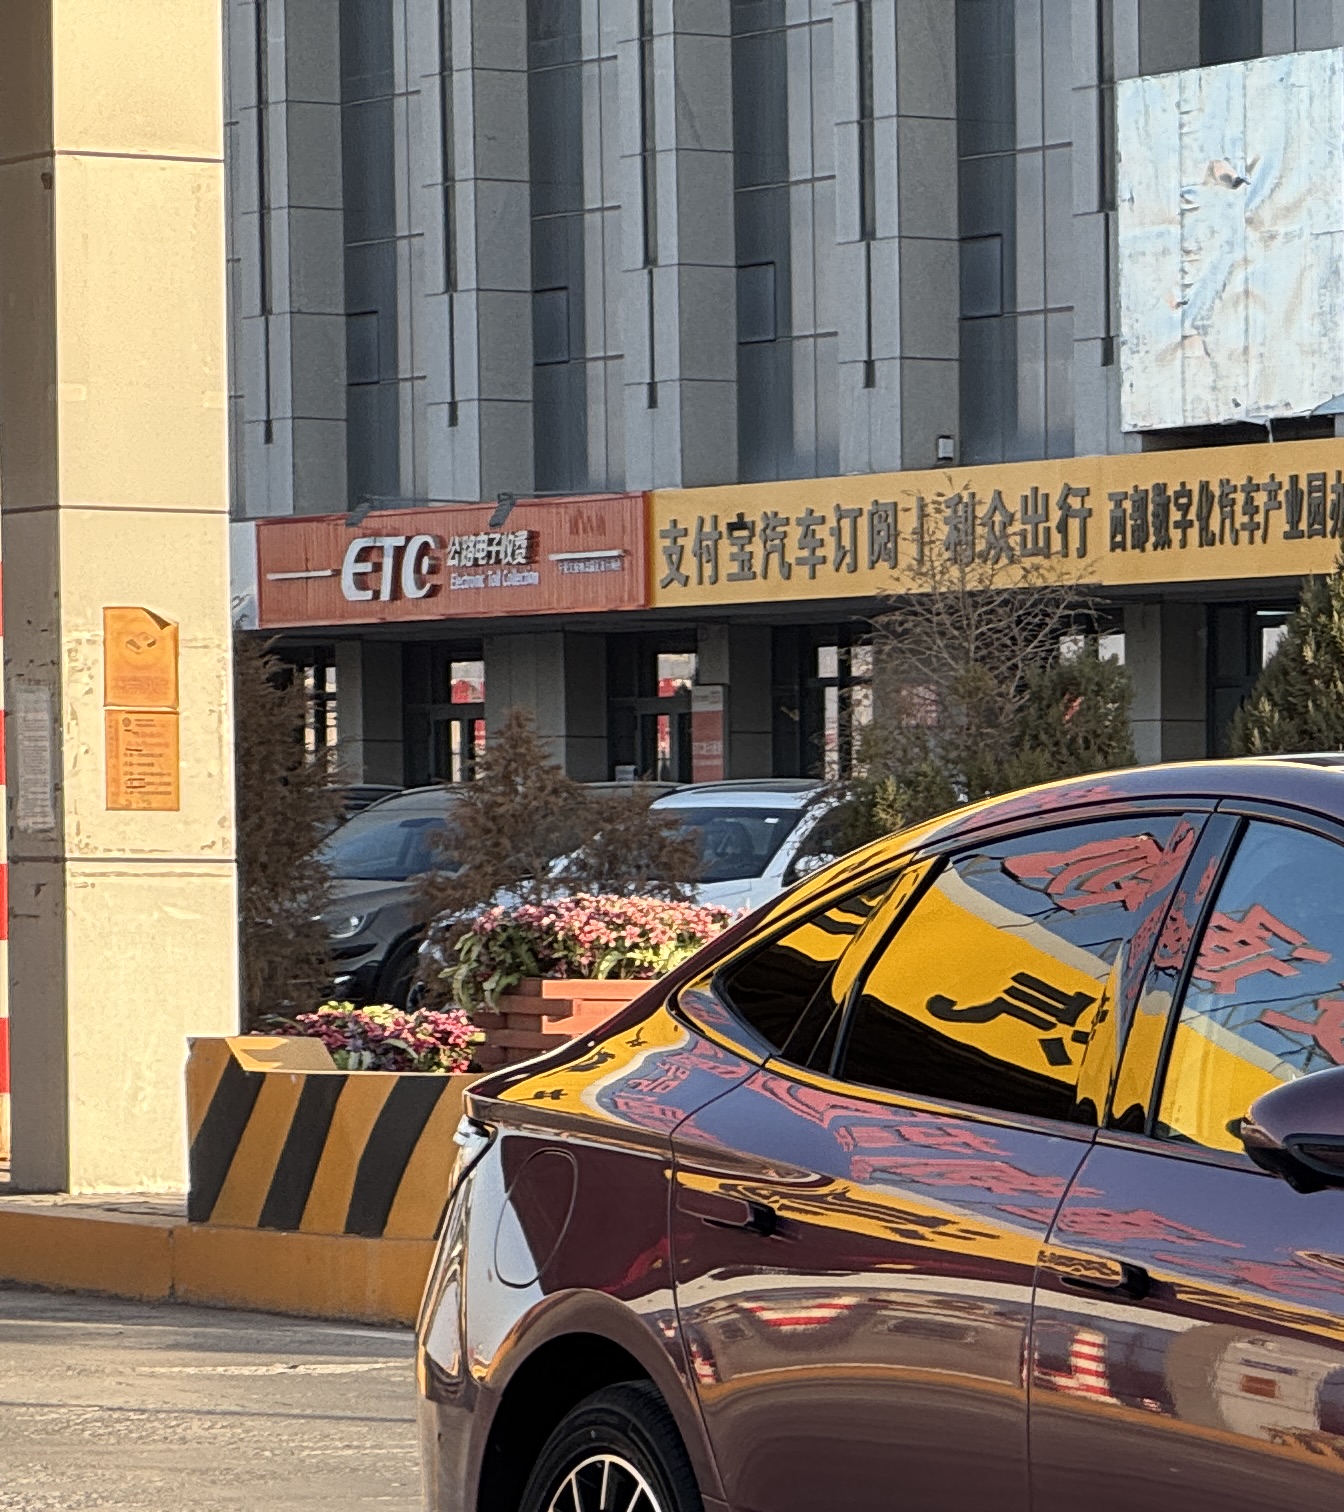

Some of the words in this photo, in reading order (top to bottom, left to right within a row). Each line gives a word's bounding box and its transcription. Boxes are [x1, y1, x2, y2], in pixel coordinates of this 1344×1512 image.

[340, 533, 438, 602] ETC
[446, 529, 530, 567] 公路电子收费
[659, 500, 899, 589] 支付宝汽车订阅
